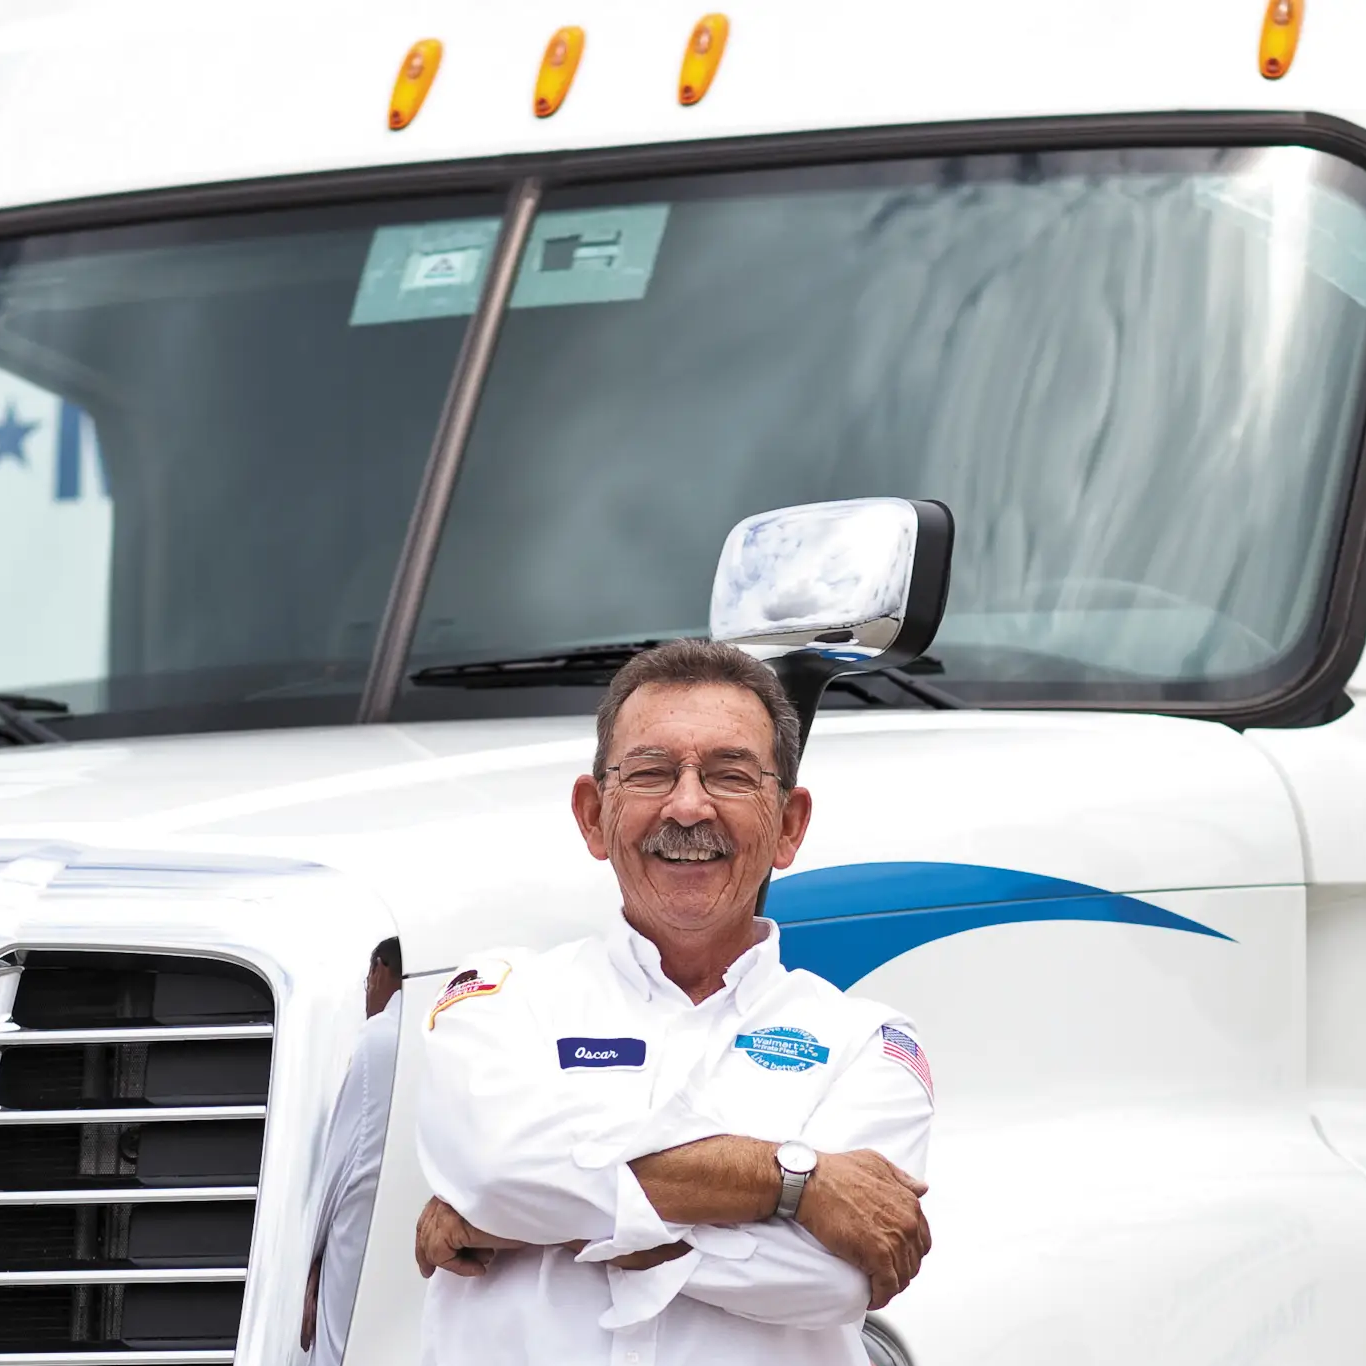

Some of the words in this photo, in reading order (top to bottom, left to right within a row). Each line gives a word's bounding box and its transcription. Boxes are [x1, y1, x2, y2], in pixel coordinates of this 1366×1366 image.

[752, 1037, 799, 1050] Walmart
[574, 1046, 618, 1059] Oscar
[751, 1053, 769, 1066] Live
